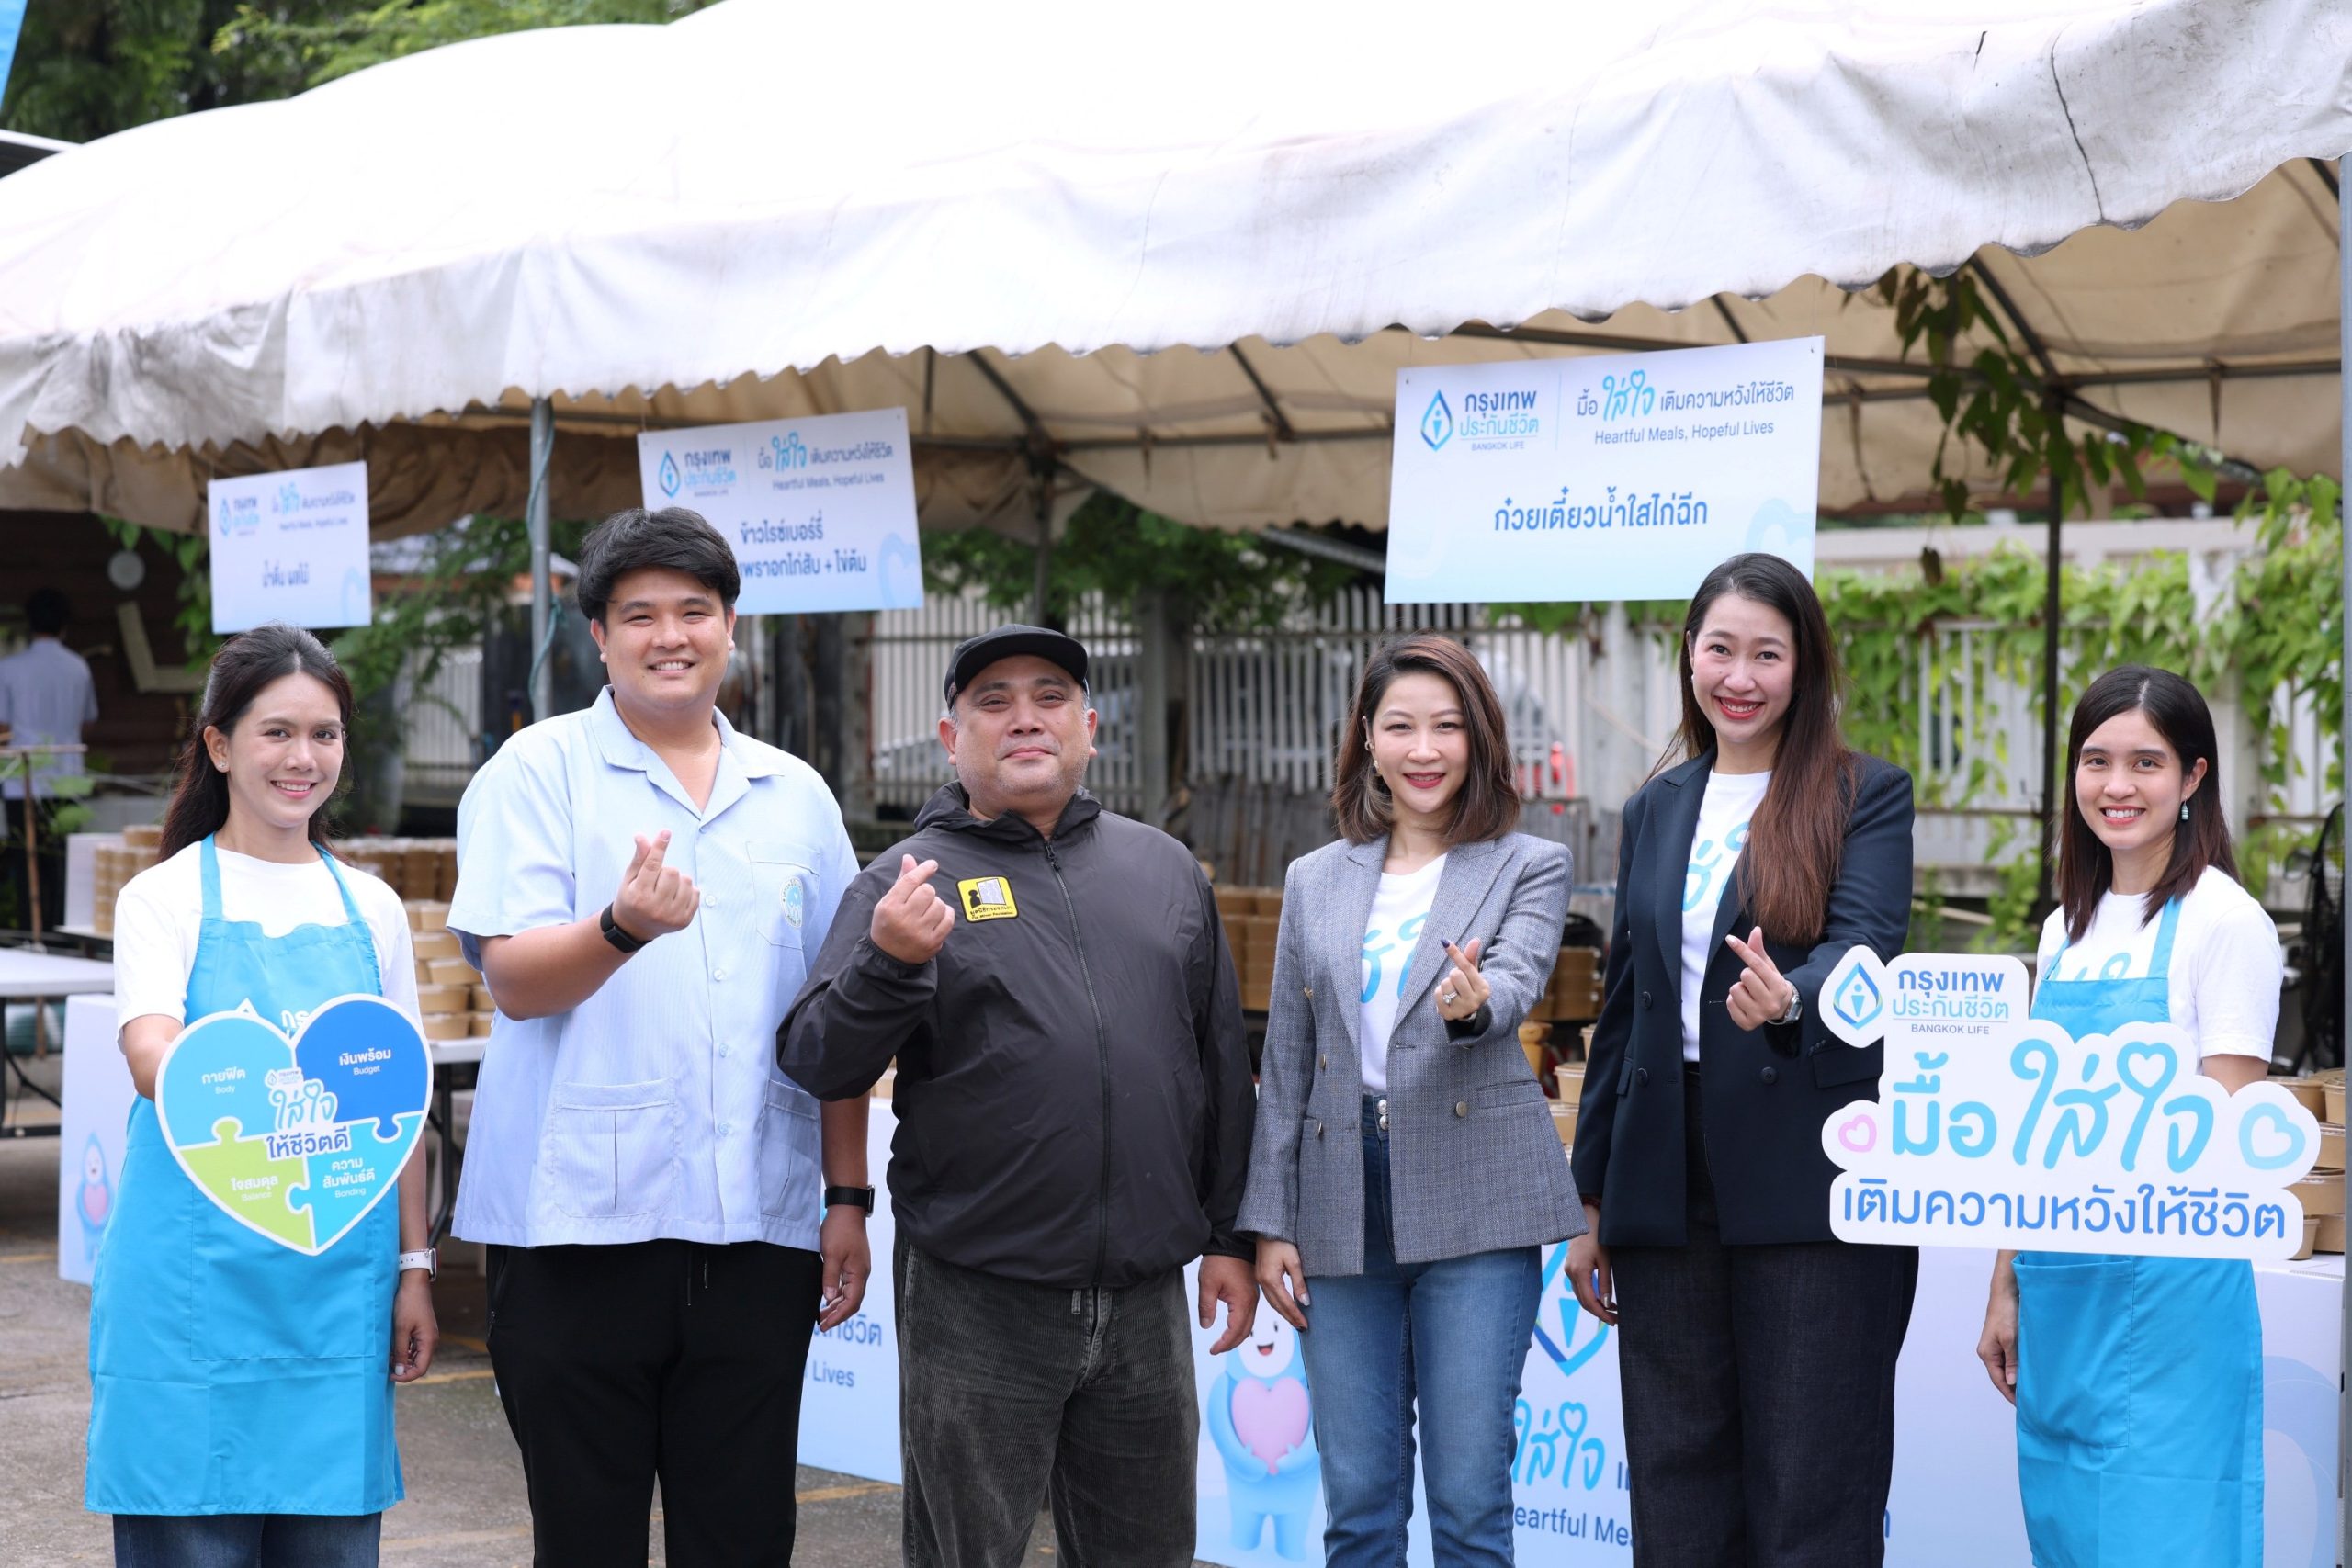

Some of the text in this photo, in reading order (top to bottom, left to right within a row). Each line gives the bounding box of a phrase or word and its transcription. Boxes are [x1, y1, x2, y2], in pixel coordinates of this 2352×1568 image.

[1464, 389, 1537, 418] กรุงเทพ
[1577, 369, 1793, 422] มื้อ ใส่ใจ เติมความหวังให้ชีวิต
[1459, 411, 1539, 437] ประกันชีวิต
[1594, 420, 1774, 445] Heartful Meals, Hopeful Lives
[1471, 440, 1525, 451] BANGKOK LIFE
[684, 448, 732, 470] กรุงเทพ
[773, 475, 804, 491] Heartful
[833, 472, 864, 488] Hopeful
[865, 472, 885, 483] Lives
[1494, 485, 1708, 531] ก๋วยเตี๋ยวน้ำใสไก่ฉีก
[741, 509, 823, 545] ข้าวไรซ์เบอร์รี่
[834, 548, 867, 574] ไข่ต้ม
[1898, 969, 2004, 998] กรุงเทพ
[1892, 992, 2009, 1019] ประกันชีวิต
[1911, 1023, 1989, 1035] BANGKOK LIFE
[339, 1047, 391, 1066] เงินพร้อม
[201, 1066, 246, 1085] กายฟิต
[353, 1065, 381, 1077] Budget
[215, 1084, 236, 1096] Body
[272, 1082, 335, 1130] ใส่ใจ
[1892, 1038, 2215, 1174] มื้อ ใส่ใจ
[267, 1126, 350, 1159] ให้ชีวิตดี
[332, 1157, 364, 1171] ความ
[231, 1175, 279, 1193] ใจสมดุล
[322, 1168, 376, 1189] สัมพันธ์ดี
[242, 1190, 272, 1201] Balance
[334, 1187, 366, 1199] Bonding
[1843, 1178, 2285, 1238] เติมความหวังให้ชีวิต
[813, 1360, 854, 1387] Lives
[1514, 1506, 1634, 1547] eartful Me
